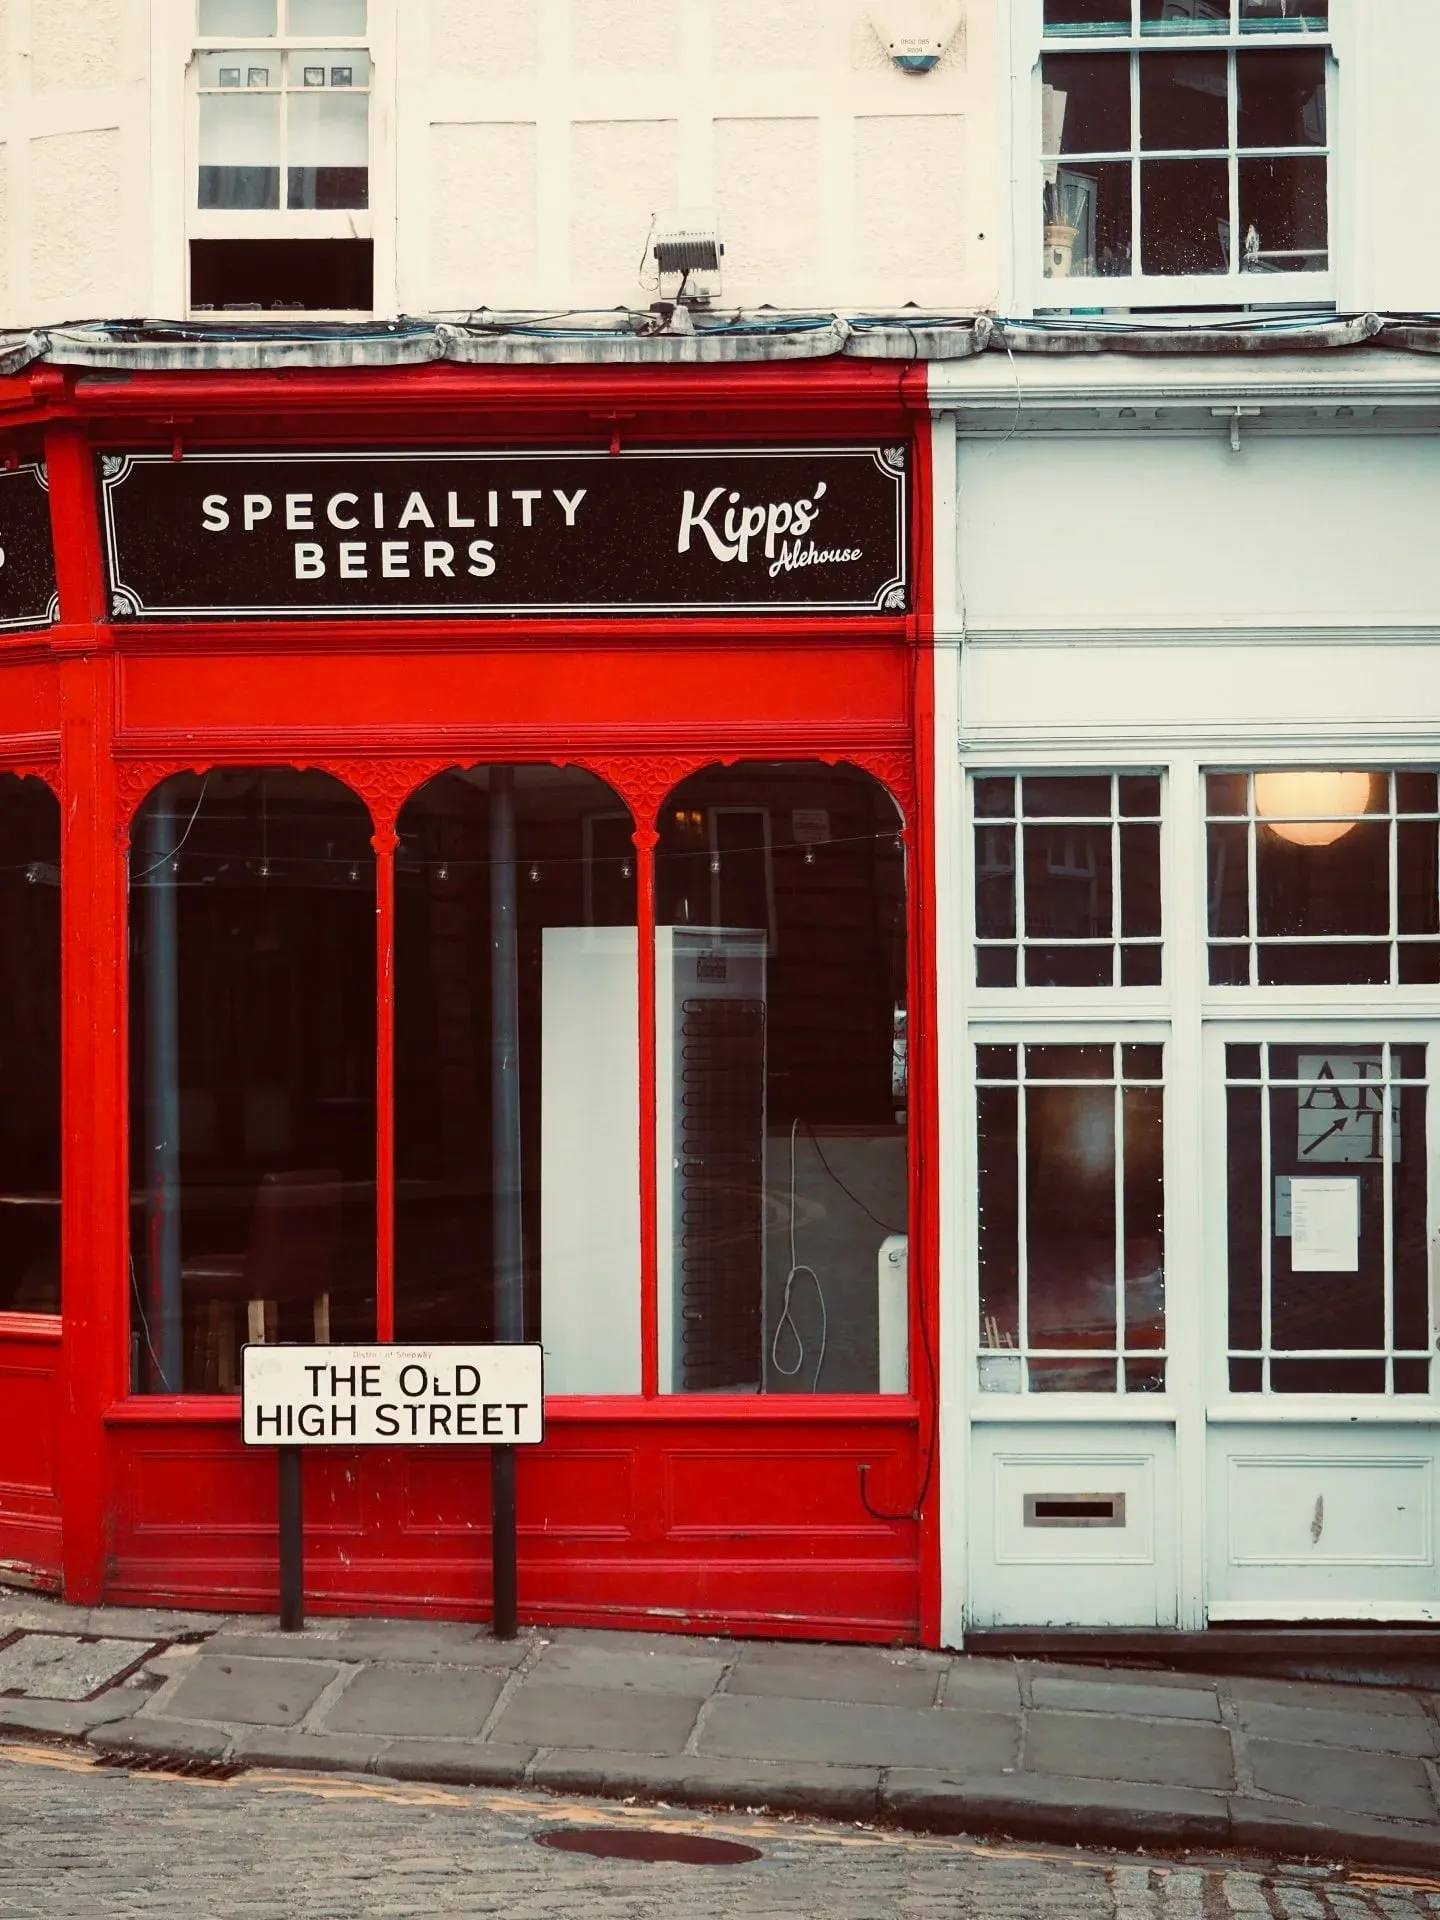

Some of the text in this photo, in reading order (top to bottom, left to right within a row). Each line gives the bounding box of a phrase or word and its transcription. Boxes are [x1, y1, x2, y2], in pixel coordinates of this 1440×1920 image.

[202, 489, 588, 532] SPECIALITY
[295, 540, 496, 579] BEERS
[768, 538, 863, 578] Alehouse
[352, 1351, 380, 1359] Distri
[304, 1364, 481, 1397] THE OLD
[256, 1403, 528, 1436] HIGH STREET
